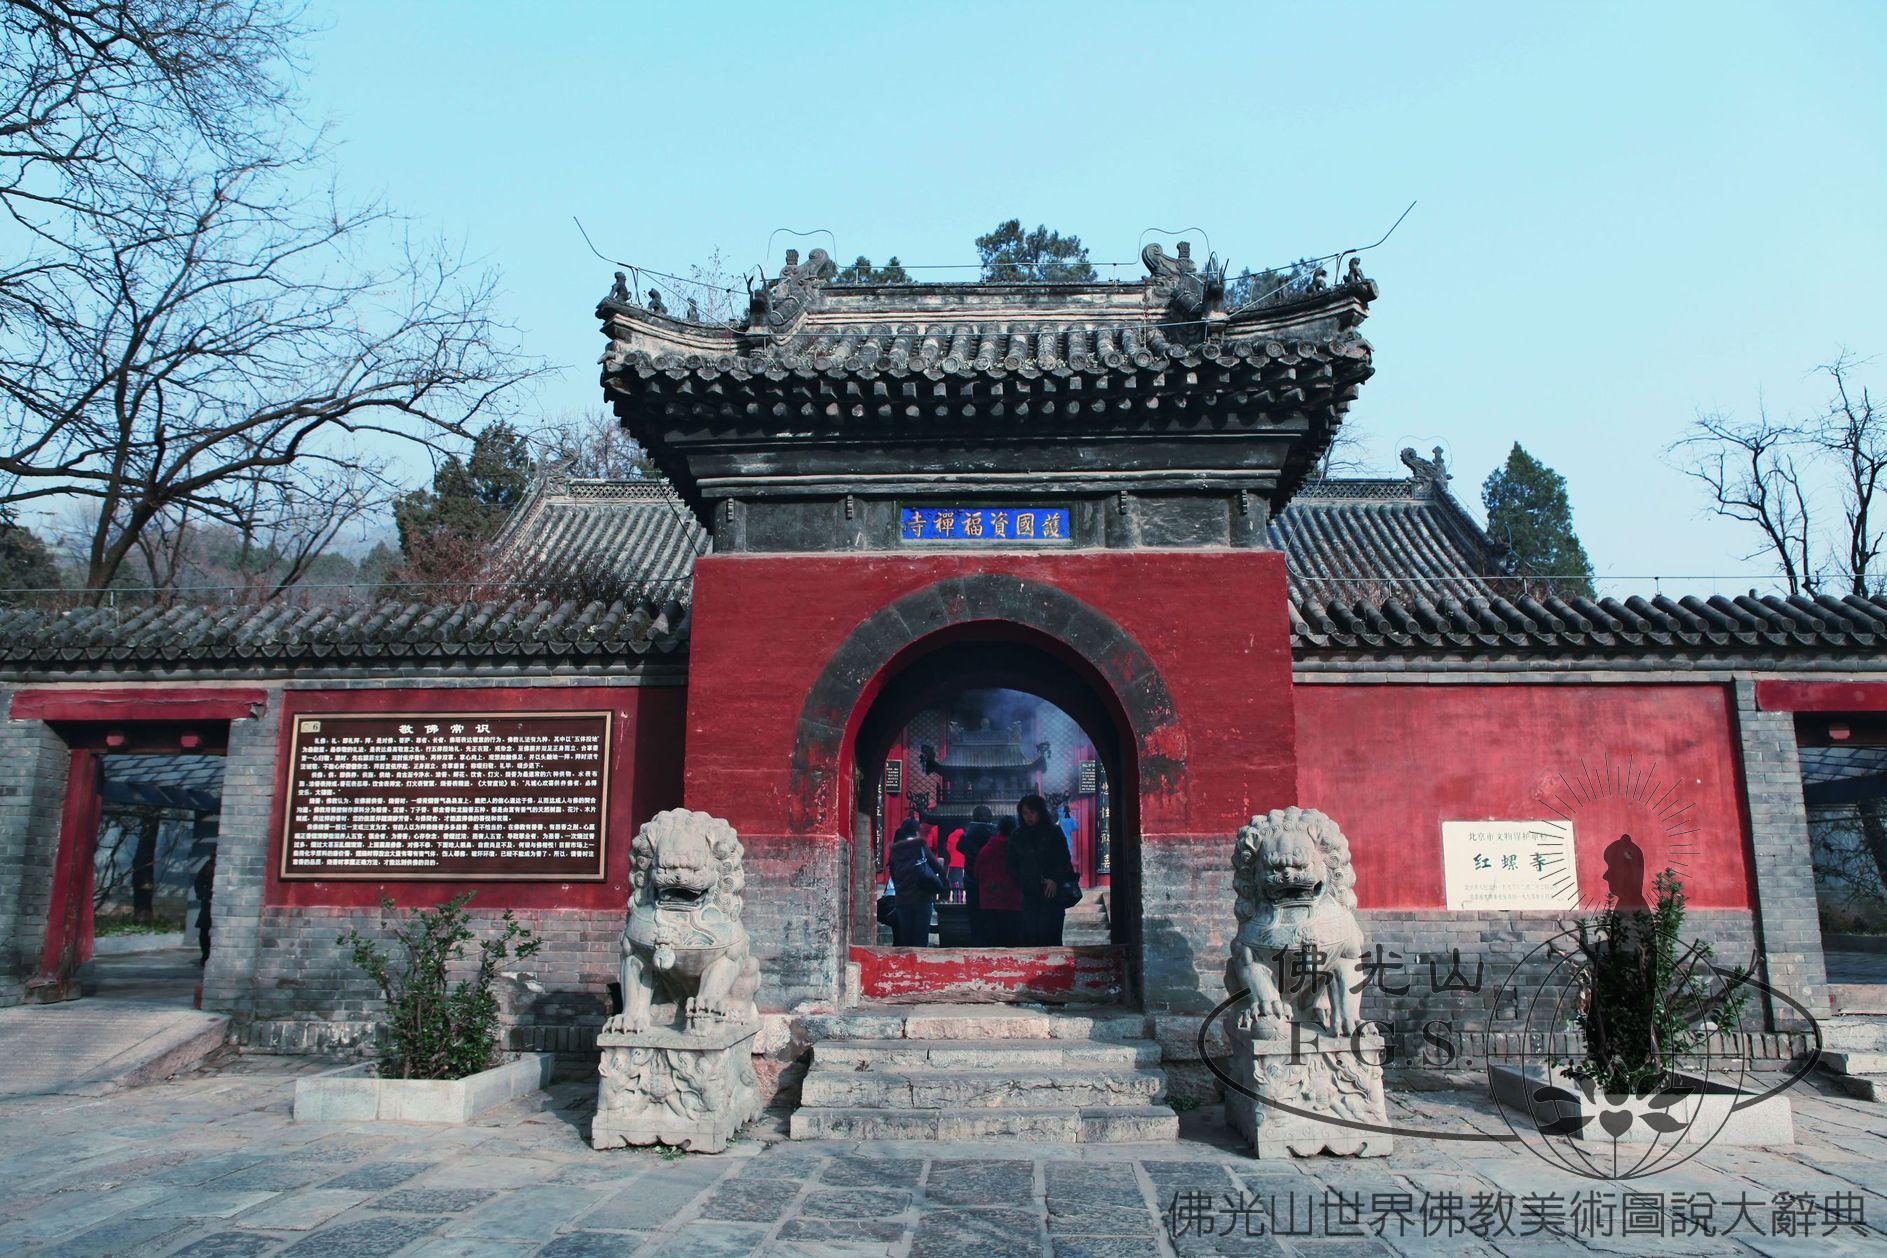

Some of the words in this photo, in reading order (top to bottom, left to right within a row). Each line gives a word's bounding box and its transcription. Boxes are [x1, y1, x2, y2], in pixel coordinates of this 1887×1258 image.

[398, 723, 491, 735] 敬佛常识
[1473, 851, 1547, 873] 红螺寺
